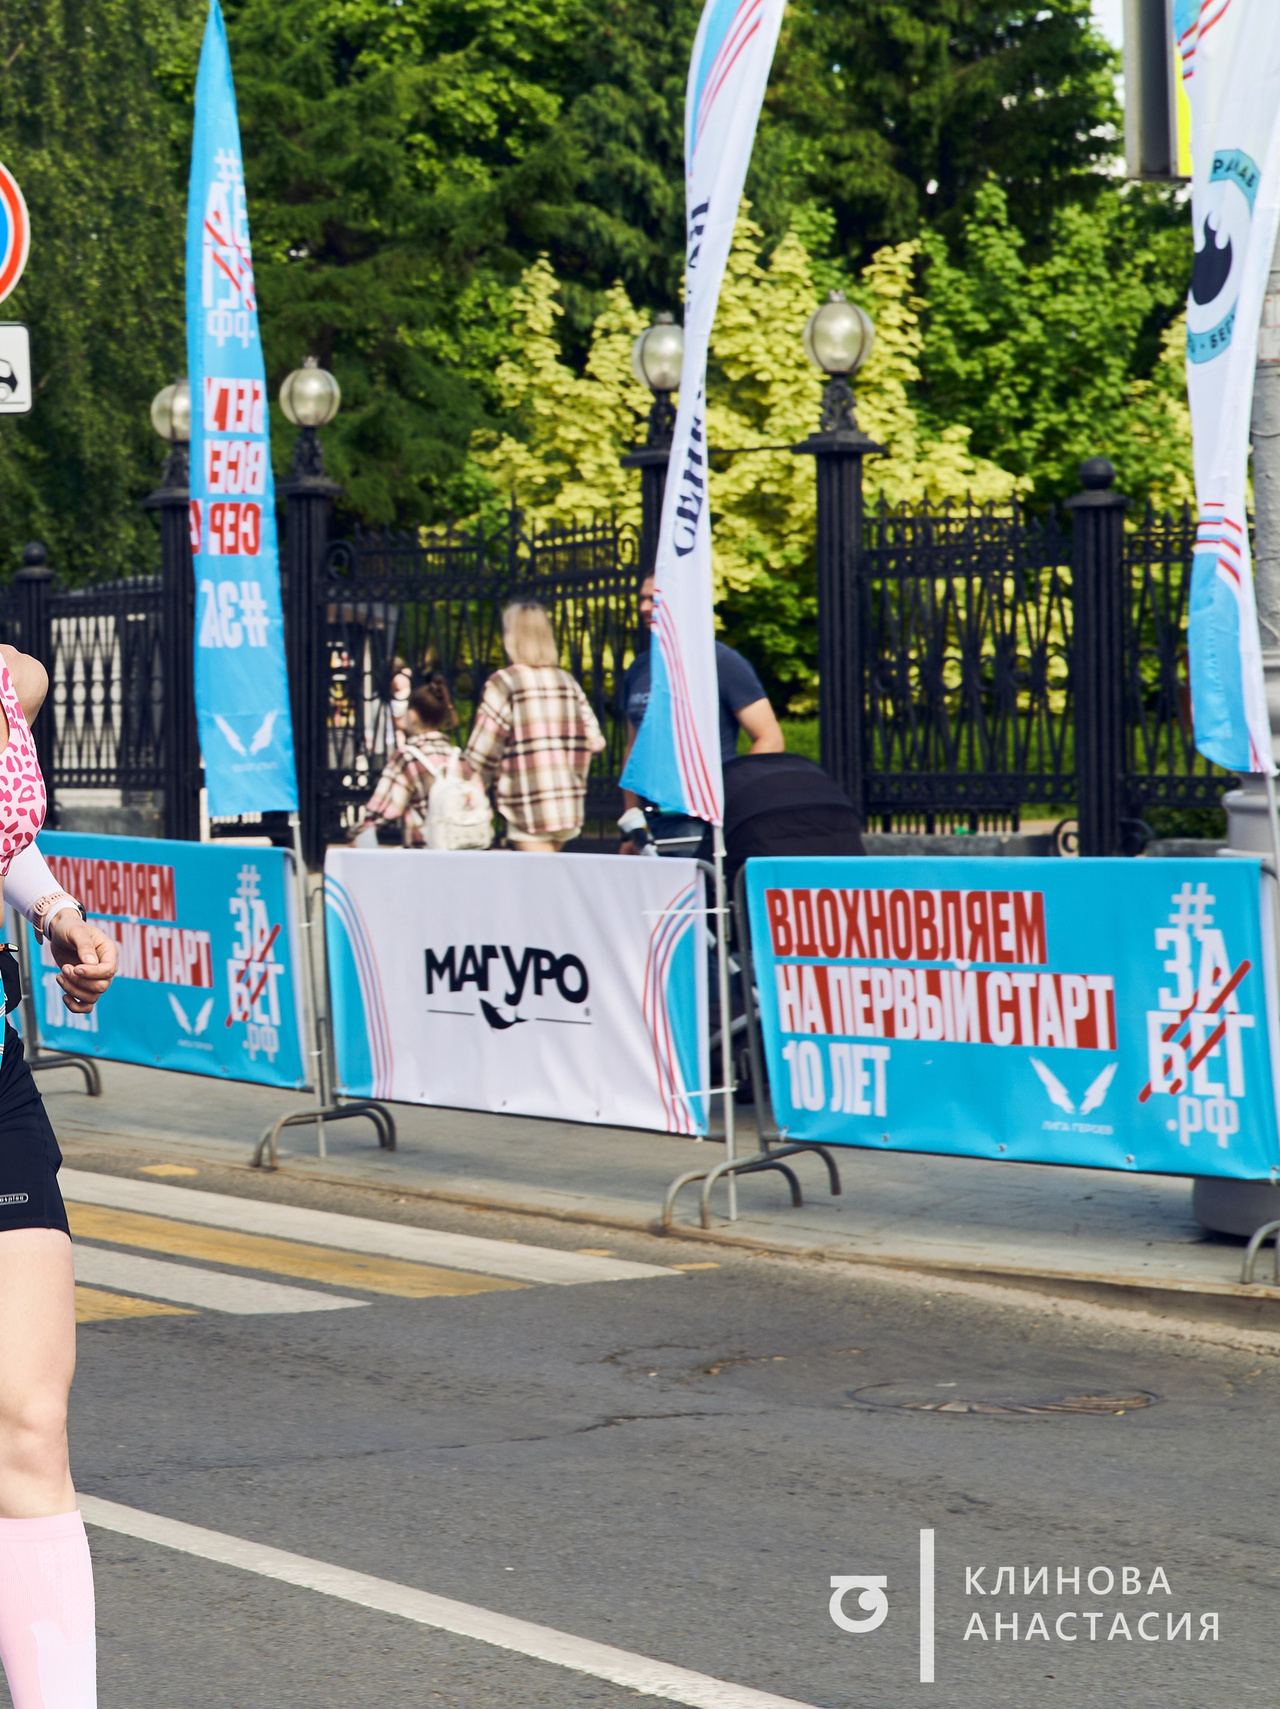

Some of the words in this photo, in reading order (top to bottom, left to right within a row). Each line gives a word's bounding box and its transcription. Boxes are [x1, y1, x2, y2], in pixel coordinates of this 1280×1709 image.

[47, 855, 177, 922] ОХНОВЛЯЕМ
[236, 864, 261, 899] #
[1169, 882, 1216, 934] #
[143, 923, 213, 988] СТАРТ
[229, 896, 275, 964] ЗА
[766, 888, 1048, 964] ВДОХНОВЛЯЕМ
[227, 959, 285, 1026] БЕГ
[424, 944, 589, 1006] МАГУРО
[1154, 927, 1240, 1012] ЗА
[775, 964, 827, 1035] НА
[828, 958, 982, 1043] ПЕРВЫЙ
[985, 970, 1118, 1051] СТАРТ
[783, 1039, 824, 1111] 10
[829, 1043, 891, 1117] ЛЕТ
[1145, 1011, 1255, 1099] БЕГ
[1166, 1098, 1240, 1149] .рф
